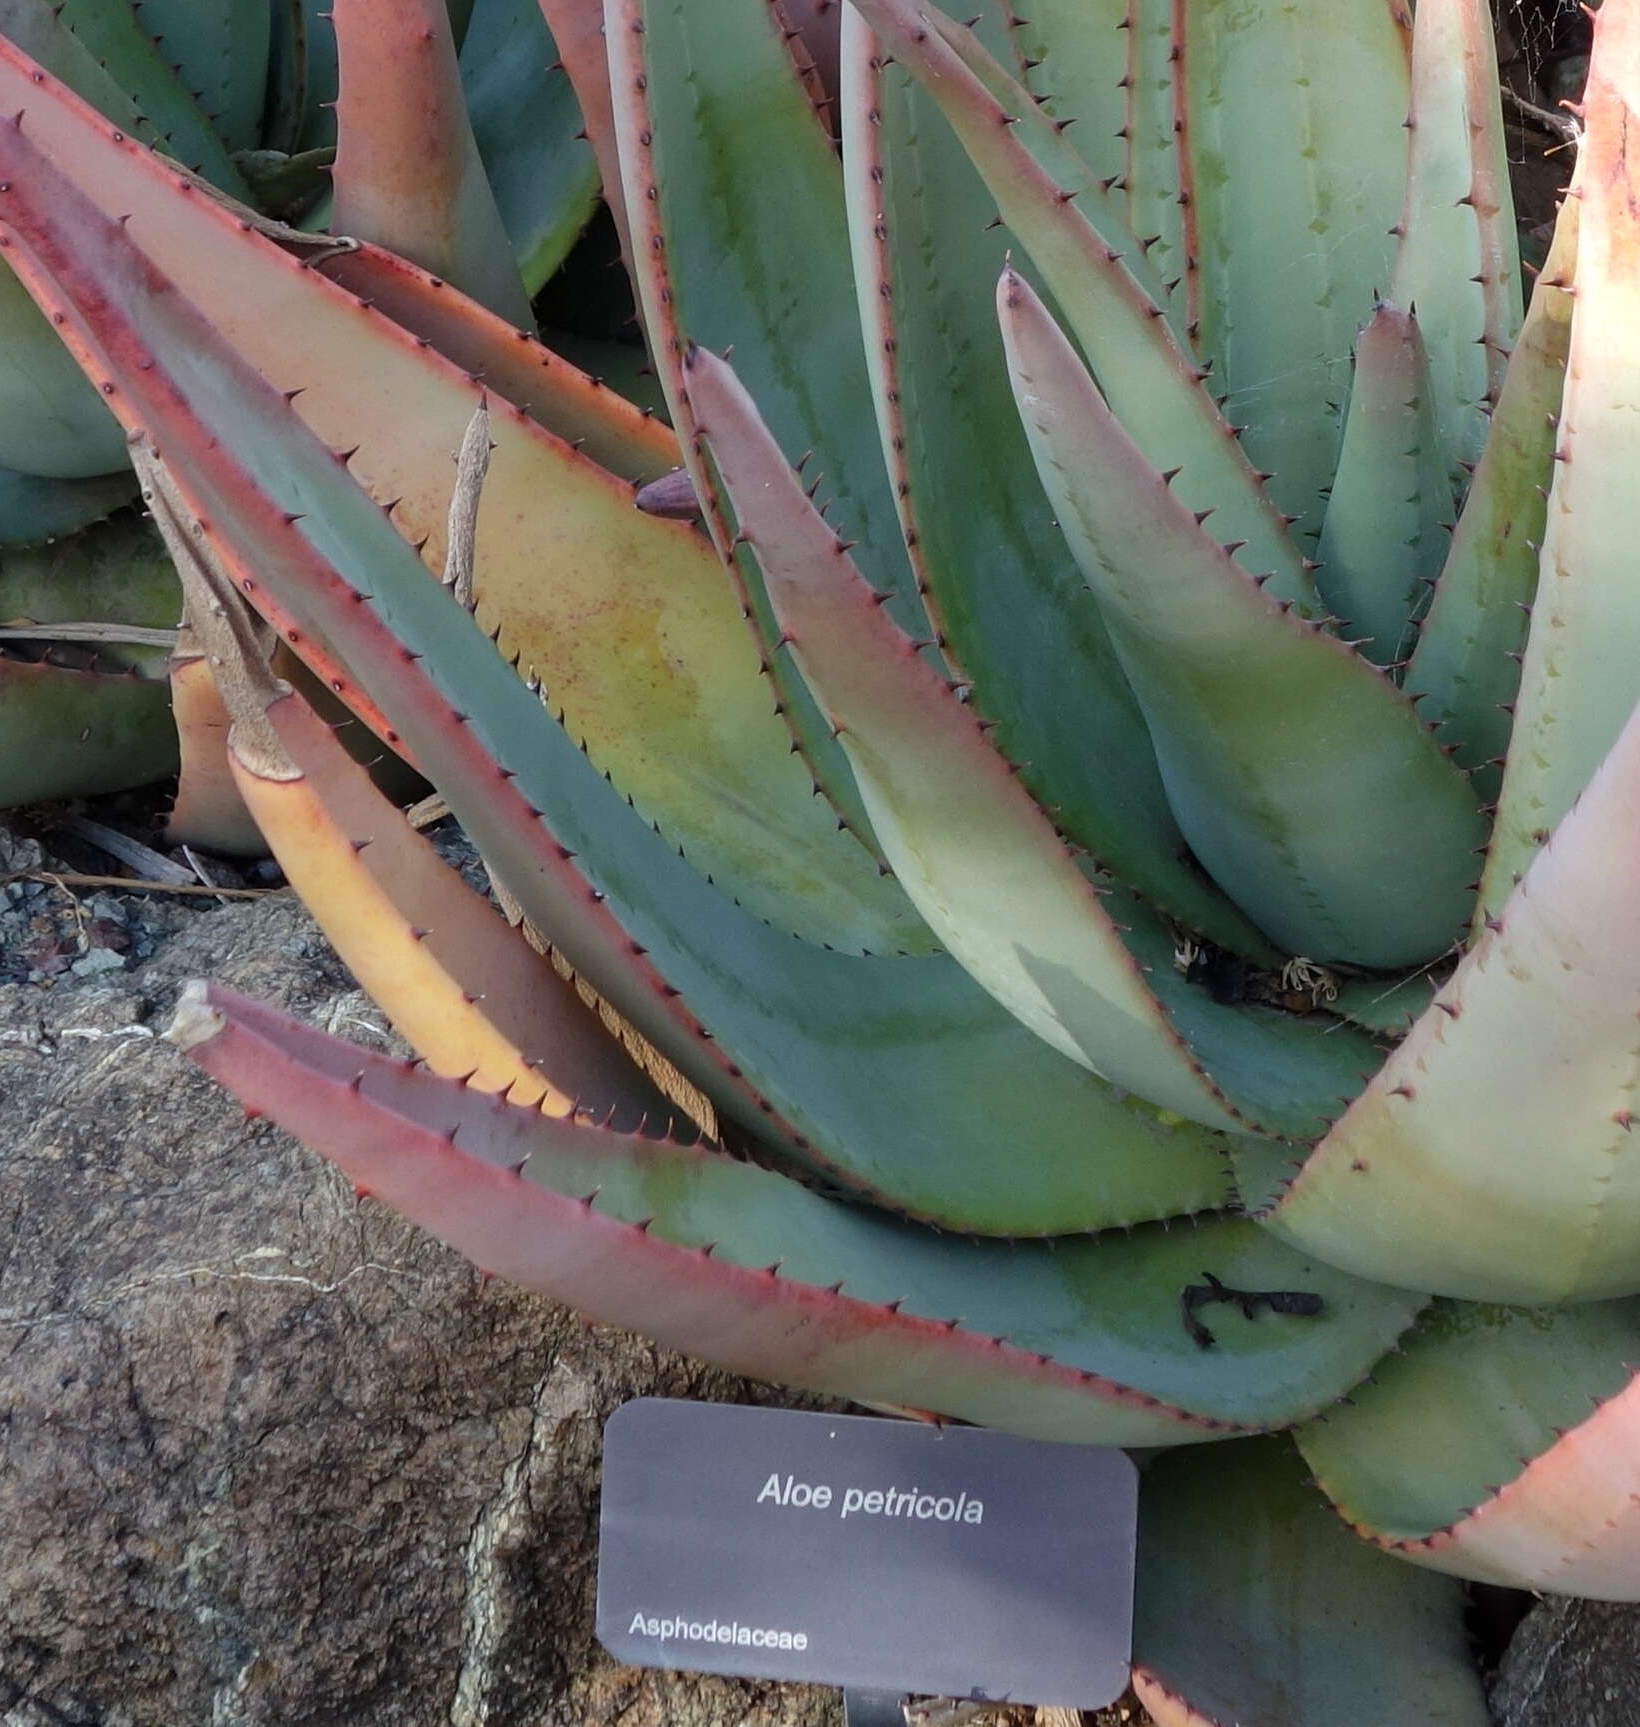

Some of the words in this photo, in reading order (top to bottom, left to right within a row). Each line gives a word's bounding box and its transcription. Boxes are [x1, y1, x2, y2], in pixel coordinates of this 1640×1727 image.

[757, 1474, 832, 1509] Aloe
[841, 1487, 983, 1524] petricola
[629, 1613, 808, 1651] Asphodelaceae
